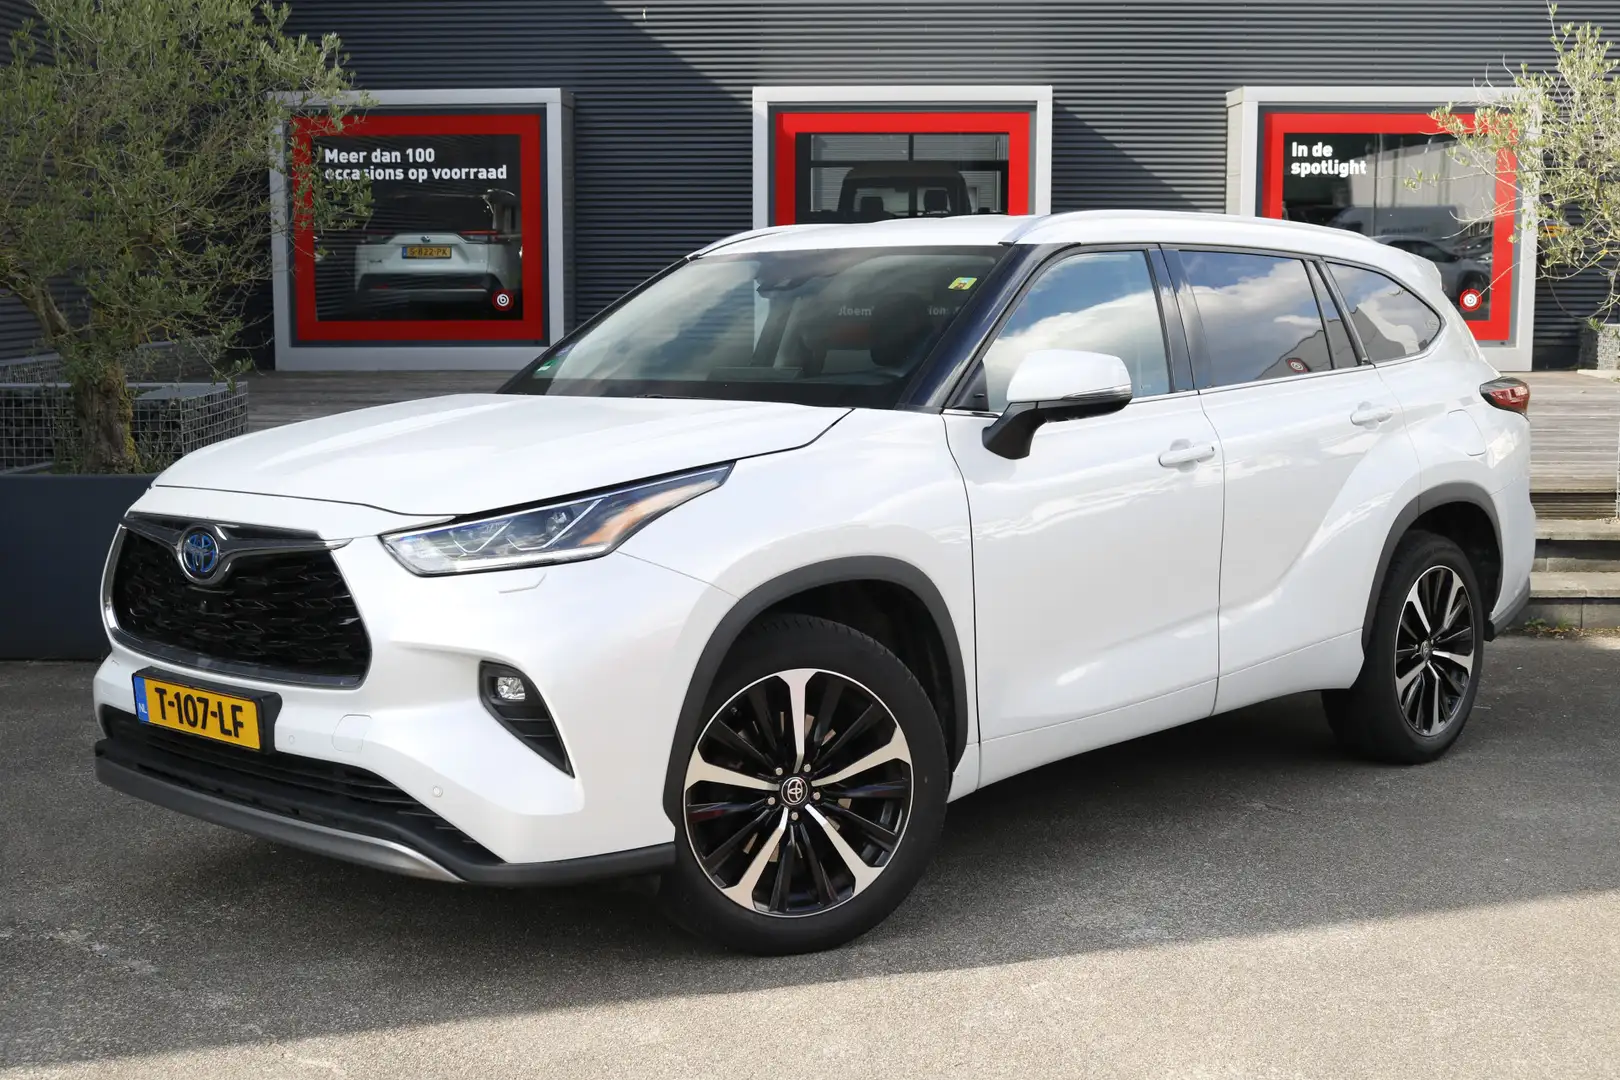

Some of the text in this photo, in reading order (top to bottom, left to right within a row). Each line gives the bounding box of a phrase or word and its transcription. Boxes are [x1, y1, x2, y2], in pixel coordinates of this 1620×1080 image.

[324, 147, 436, 163] Meer dan 100
[1291, 141, 1333, 157] In de
[408, 167, 428, 183] op
[431, 164, 507, 179] voorraad
[1290, 159, 1367, 178] spotlight
[138, 702, 148, 714] NL
[154, 687, 244, 738] T-107-LF
